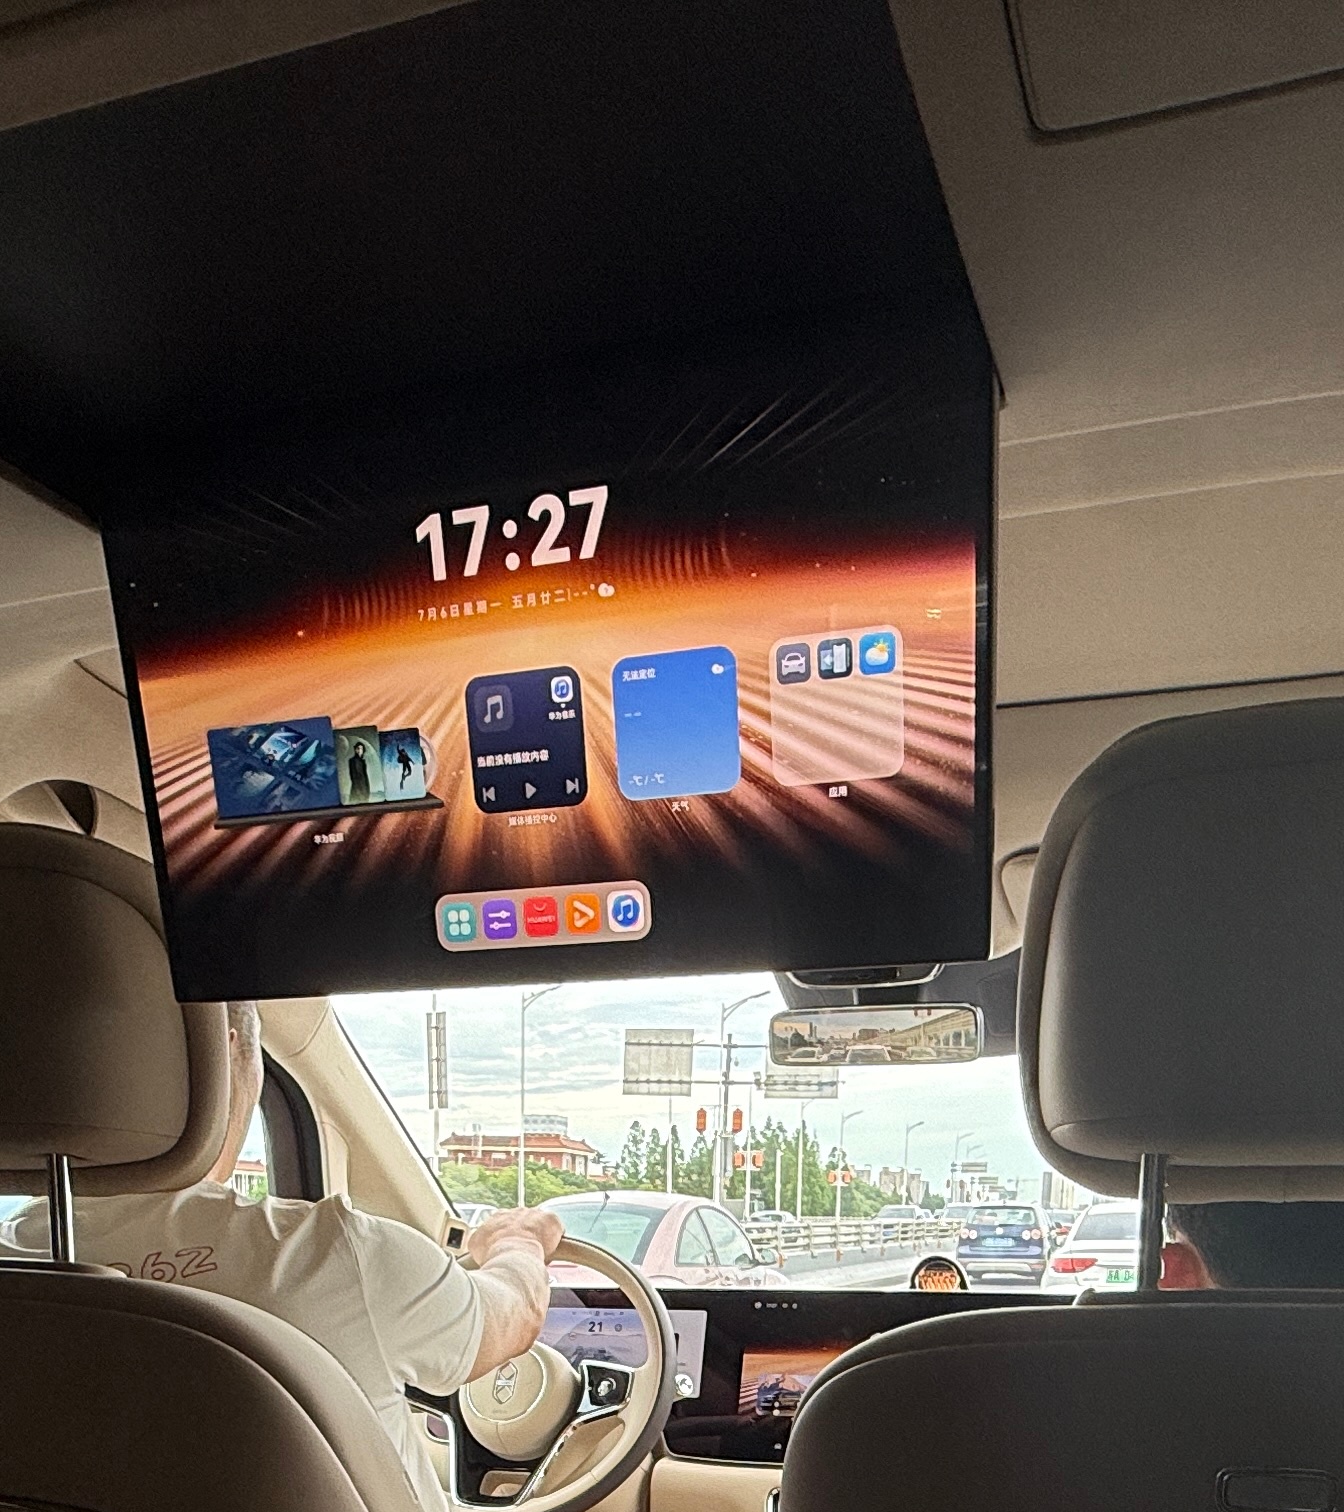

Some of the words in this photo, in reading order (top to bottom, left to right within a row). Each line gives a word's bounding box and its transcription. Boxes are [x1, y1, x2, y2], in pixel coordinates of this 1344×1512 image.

[416, 485, 608, 581] 17:27
[477, 749, 549, 768] 当前没有播放内容
[671, 800, 690, 812] 天气
[588, 1321, 603, 1333] 21
